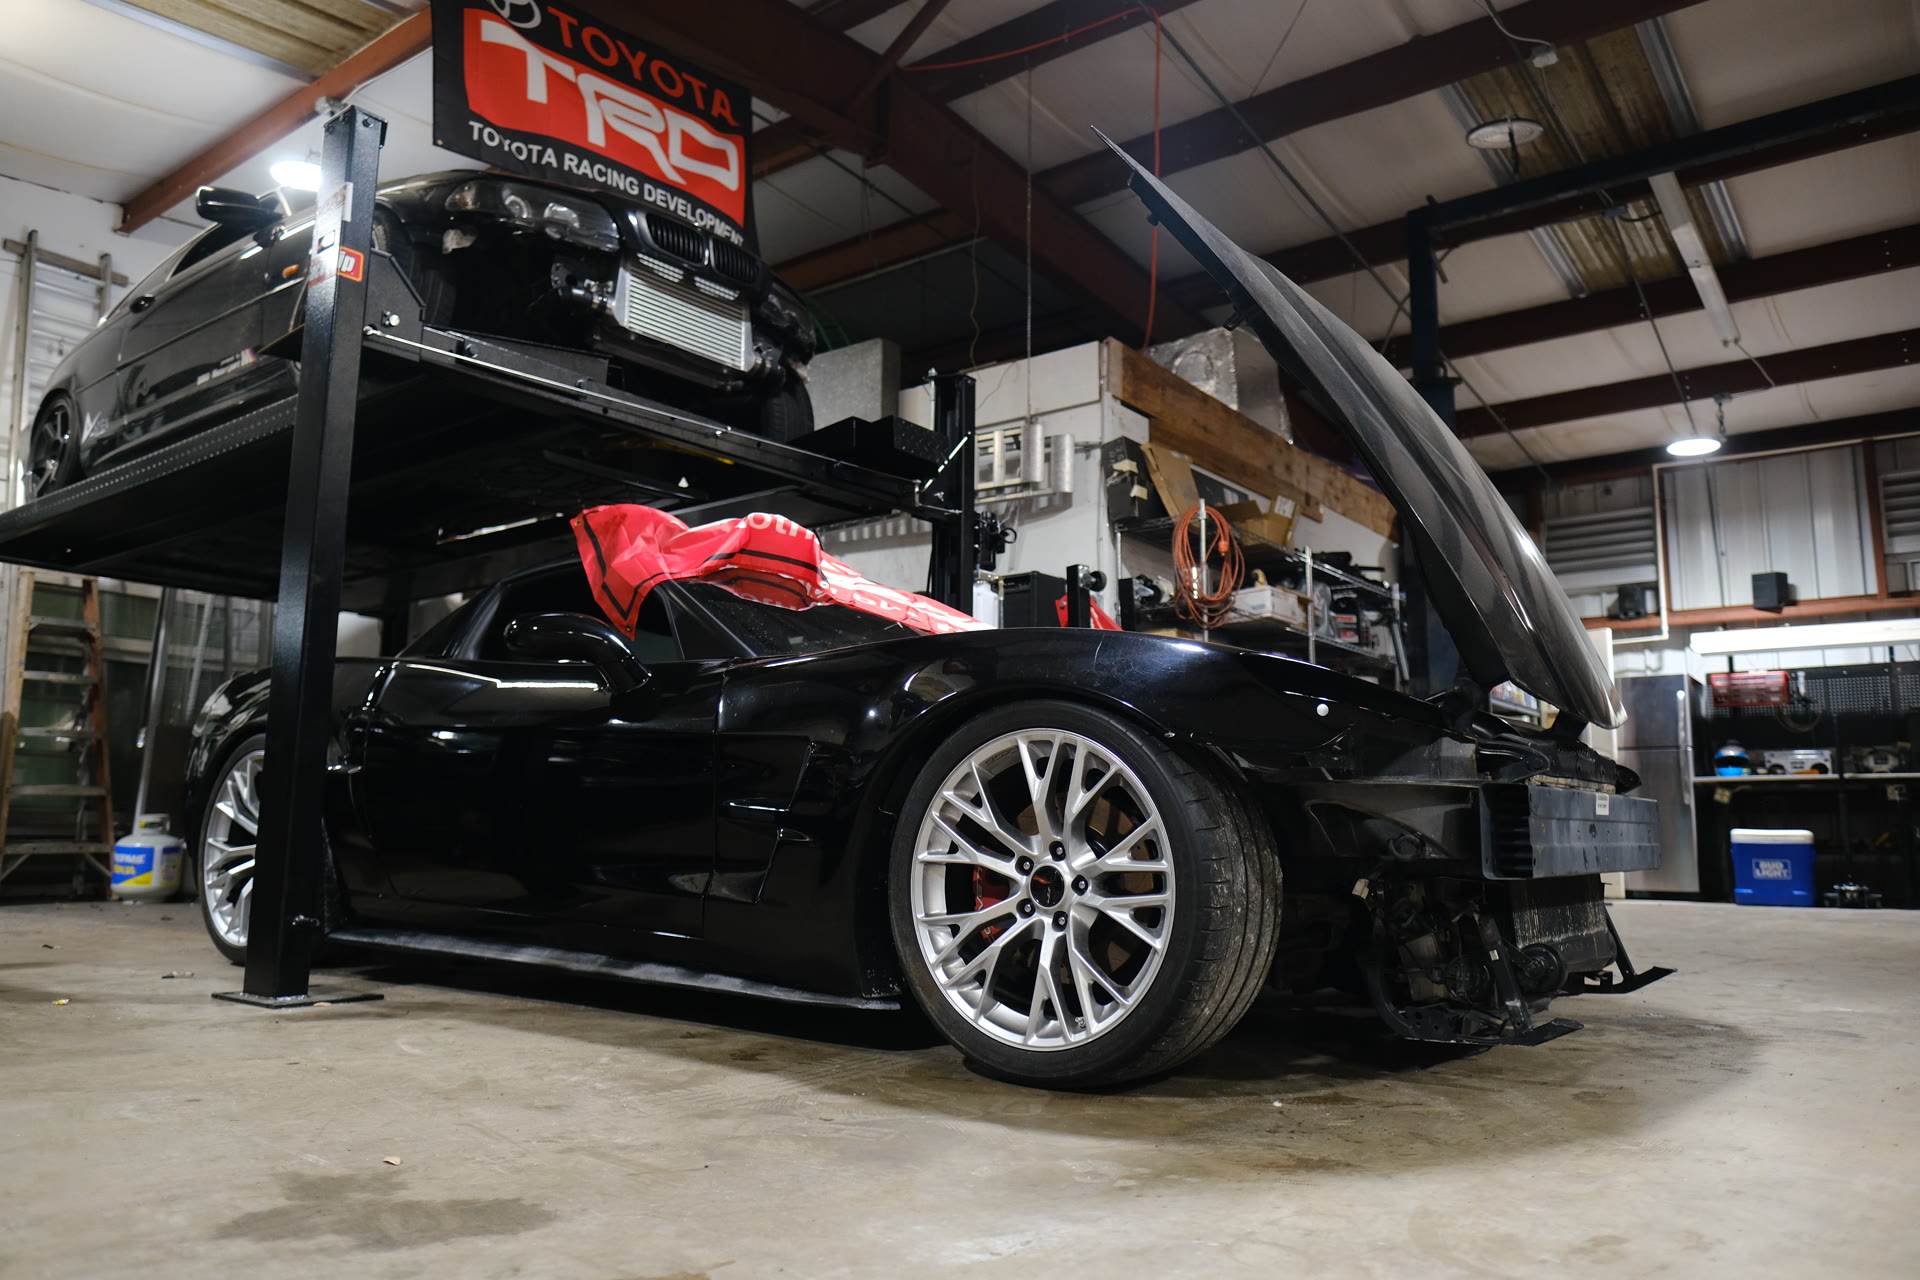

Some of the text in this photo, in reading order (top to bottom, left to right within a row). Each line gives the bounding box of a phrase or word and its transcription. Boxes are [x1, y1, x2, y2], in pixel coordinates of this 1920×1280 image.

[481, 19, 739, 191] TRD
[547, 5, 740, 126] TOYOTA
[468, 120, 744, 246] TOYOTA RACING DEVELOPMENT
